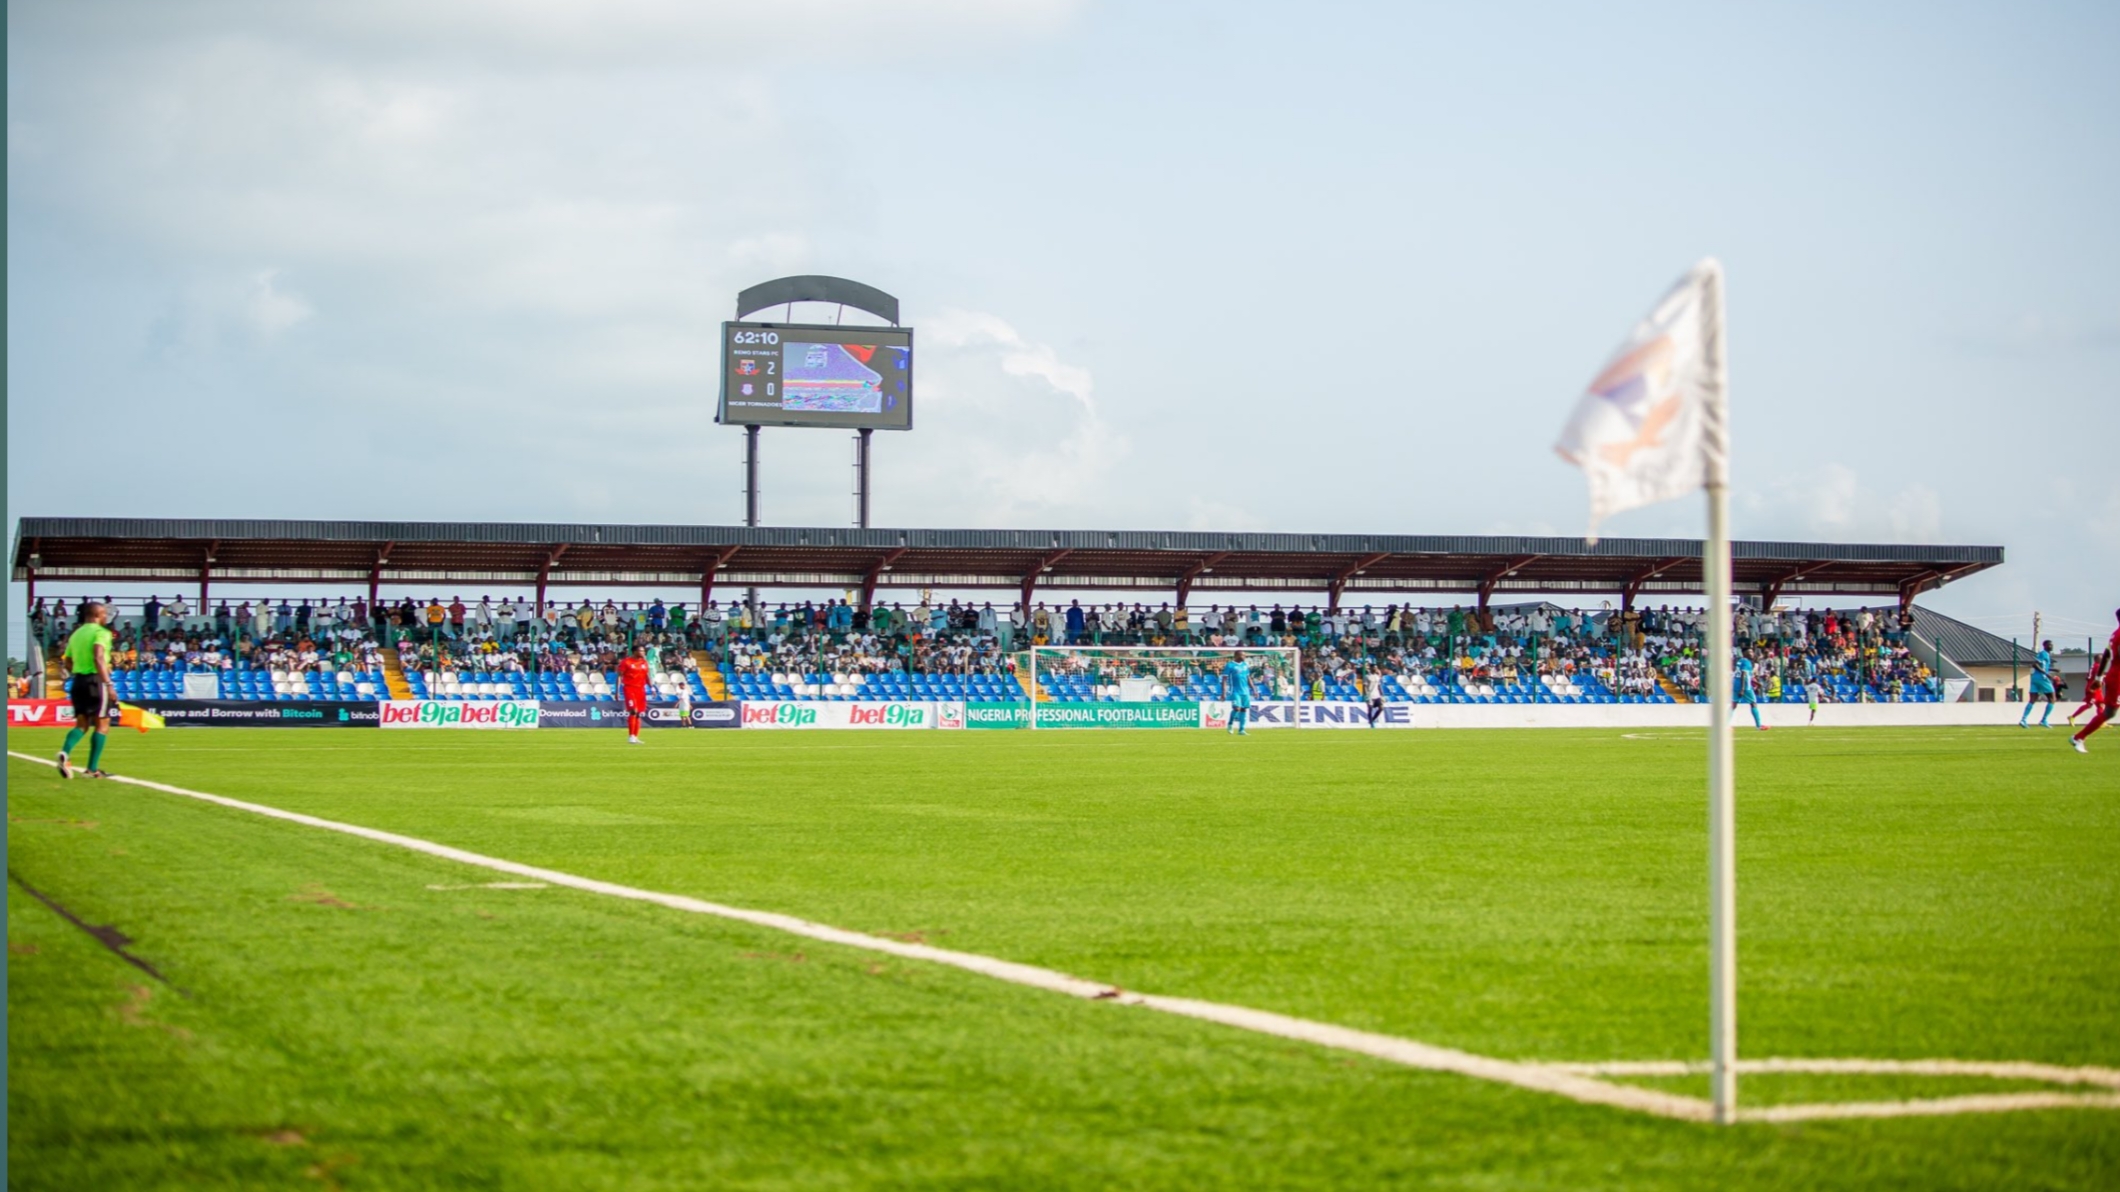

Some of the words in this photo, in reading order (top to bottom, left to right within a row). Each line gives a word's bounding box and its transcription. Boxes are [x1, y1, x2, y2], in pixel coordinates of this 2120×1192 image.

[734, 331, 779, 345] 62:10
[767, 361, 776, 375] 2
[767, 382, 775, 396] 0
[188, 709, 209, 717] and
[212, 709, 252, 717] Borrow
[255, 709, 280, 717] with
[283, 709, 322, 718] Bitcoin
[382, 702, 460, 725] bet9ja
[460, 702, 537, 726] bet9ja
[540, 709, 586, 717] Download
[742, 703, 816, 727] bet9ja
[849, 704, 923, 727] bet9ja
[968, 708, 1010, 721] NIGERIA
[1098, 708, 1153, 721] FOOTBALL
[1156, 708, 1197, 721] LEAGUE
[1233, 705, 1410, 723] KENNE
